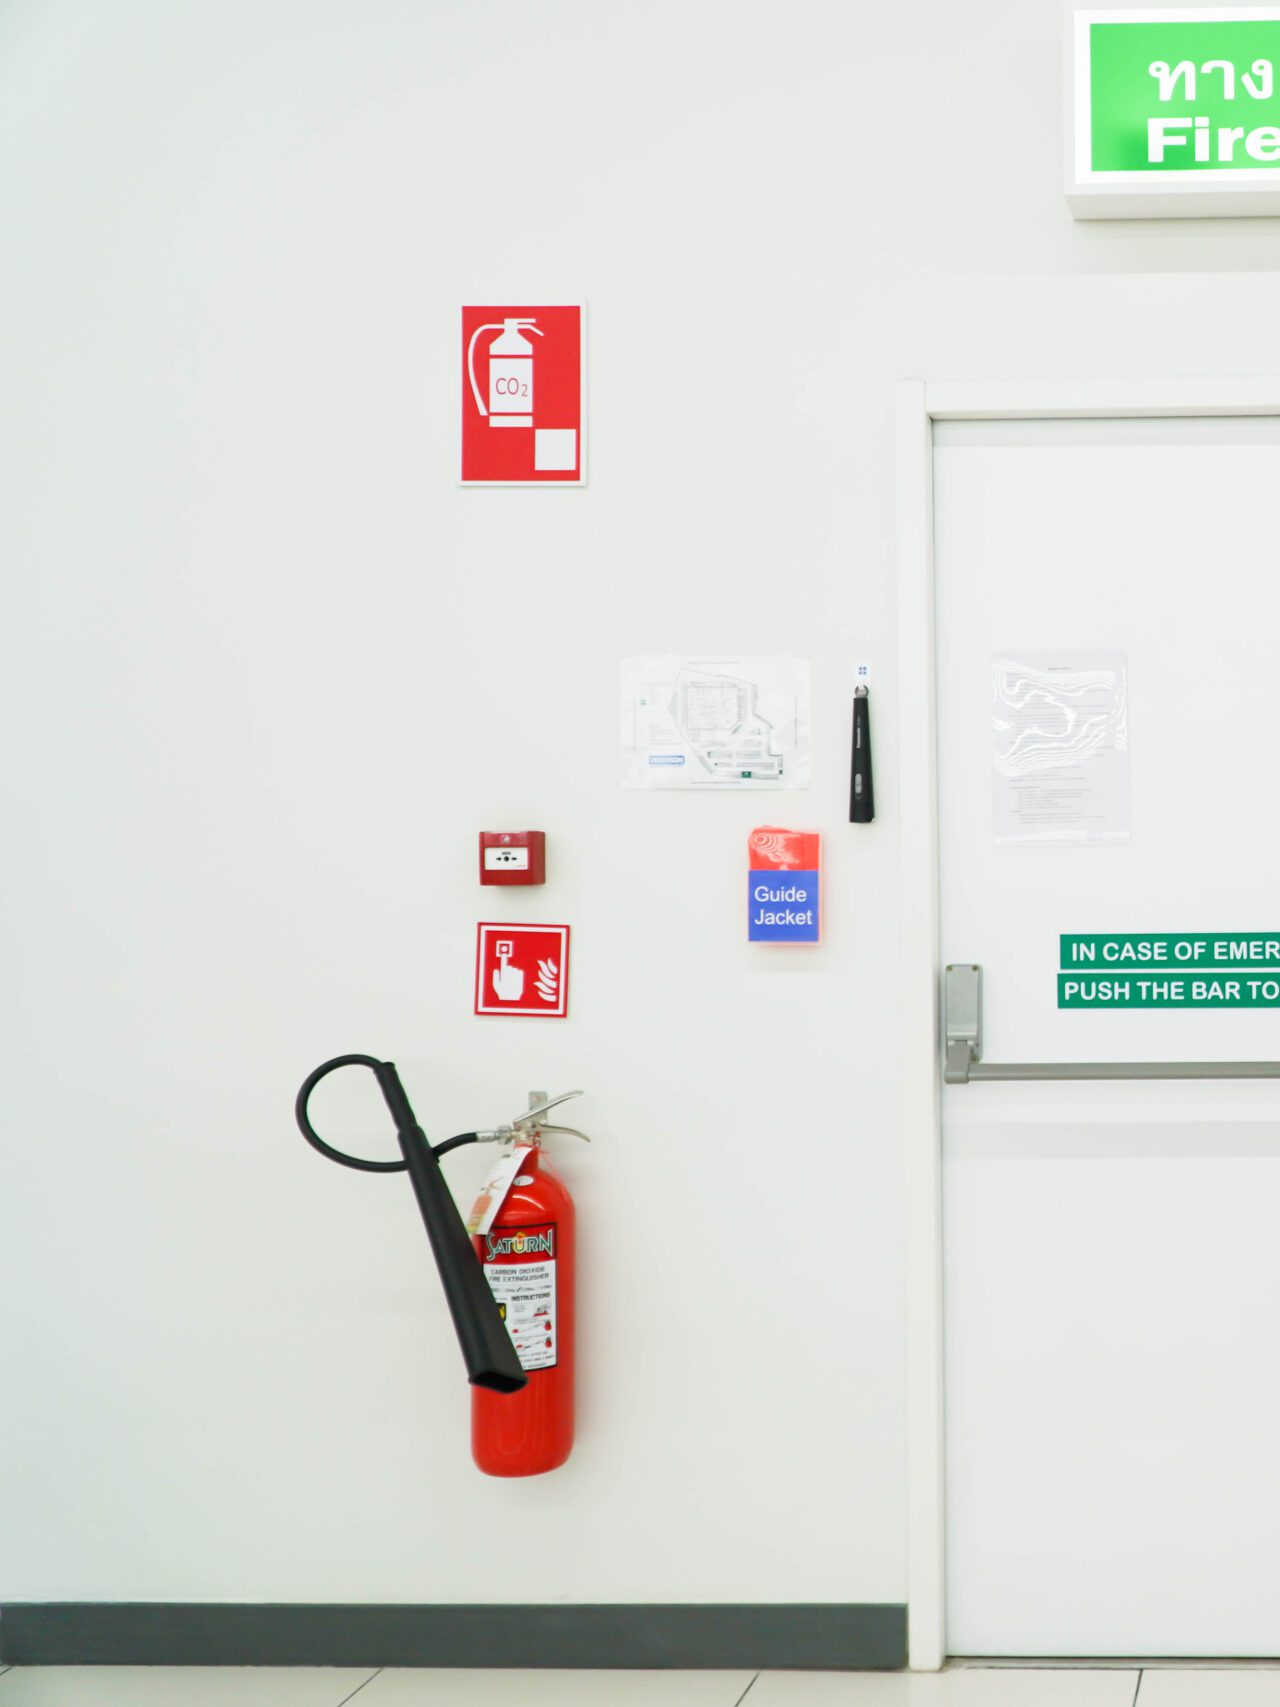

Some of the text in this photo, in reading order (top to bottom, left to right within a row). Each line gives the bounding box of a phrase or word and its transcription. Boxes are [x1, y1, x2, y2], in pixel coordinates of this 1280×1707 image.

[754, 886, 807, 902] Guide
[754, 909, 812, 925] Jacket
[1072, 942, 1096, 962] IN
[1103, 942, 1168, 961] CASE
[1174, 941, 1207, 961] OF
[1064, 982, 1130, 1000] PUSH
[1137, 982, 1184, 1000] THE
[1191, 981, 1241, 1000] BAR
[1247, 981, 1280, 1000] TO
[486, 1228, 553, 1261] SATURN
[511, 1292, 551, 1301] INSTRUCTIONS
